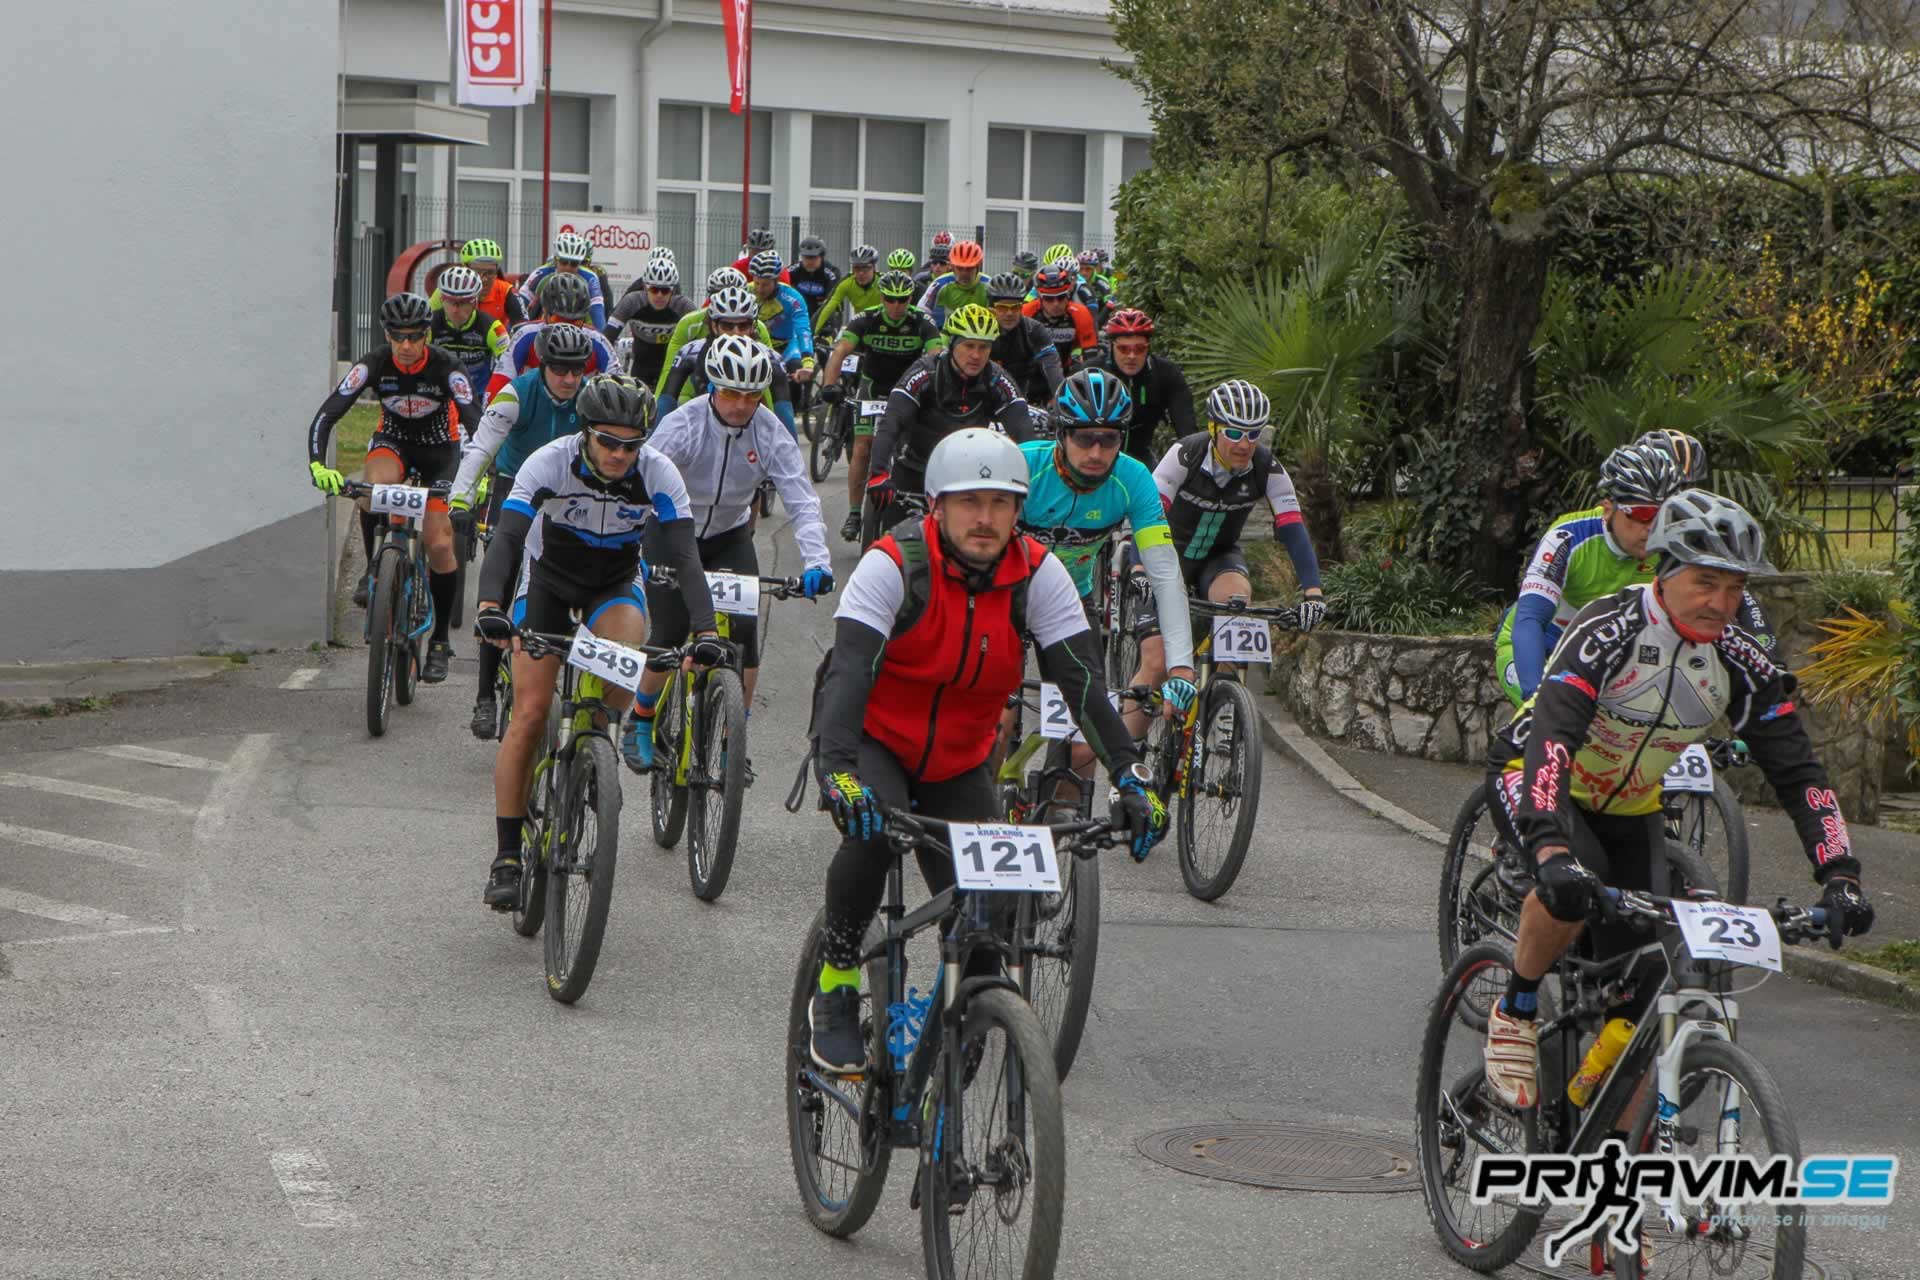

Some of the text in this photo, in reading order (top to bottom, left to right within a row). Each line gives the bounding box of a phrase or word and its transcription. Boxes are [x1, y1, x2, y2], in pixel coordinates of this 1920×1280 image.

[584, 224, 651, 251] ciciban
[377, 489, 422, 509] 198
[710, 580, 742, 602] 41
[1219, 629, 1268, 652] 120
[577, 639, 639, 679] 349
[961, 841, 1047, 873] 121
[1701, 916, 1761, 948] 23
